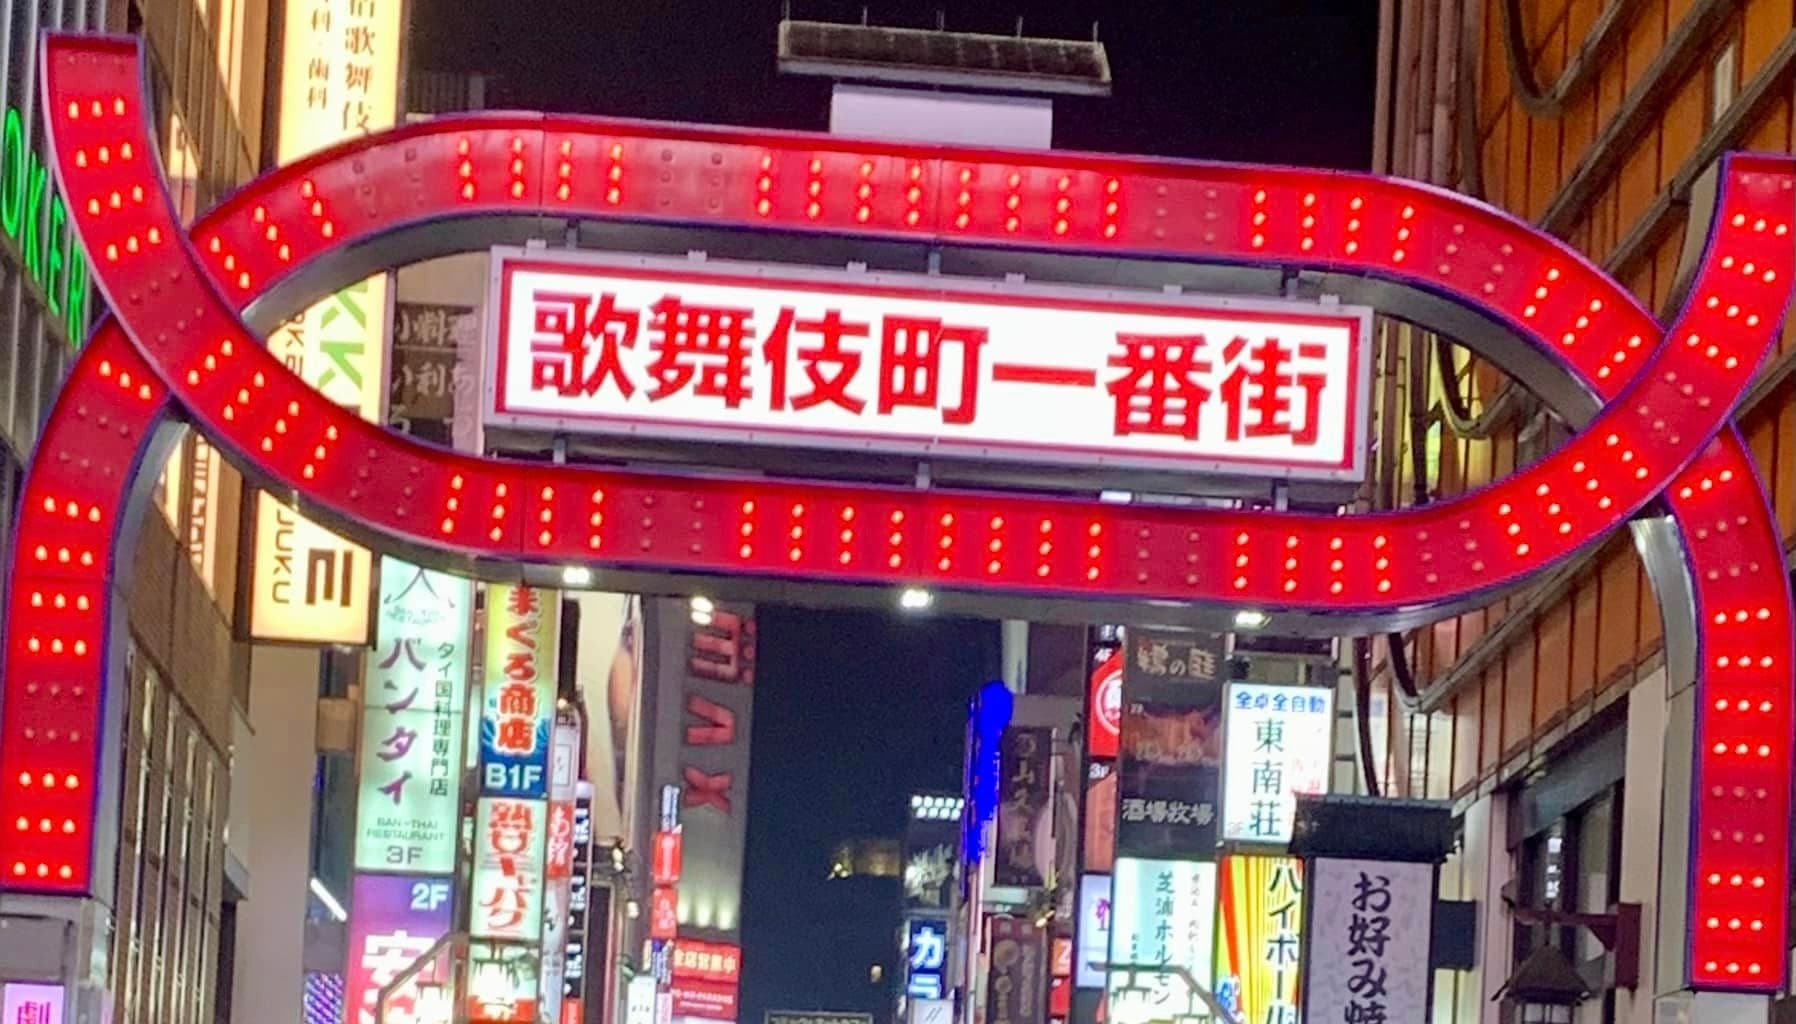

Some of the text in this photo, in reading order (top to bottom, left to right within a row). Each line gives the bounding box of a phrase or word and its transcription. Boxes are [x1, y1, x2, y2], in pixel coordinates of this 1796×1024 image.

[529, 289, 1329, 447] 歌舞伎町一番街
[376, 636, 428, 806] バンタイ
[429, 640, 457, 797] タイ国料理専門店
[1235, 690, 1326, 714] 全卓全自動
[485, 762, 542, 790] B1F
[1121, 797, 1214, 827] 酒場牧場
[1249, 717, 1286, 837] 東南荘
[385, 844, 424, 866] 3F
[411, 881, 448, 908] 2F
[1153, 870, 1176, 1006] 芝浦ホルモン
